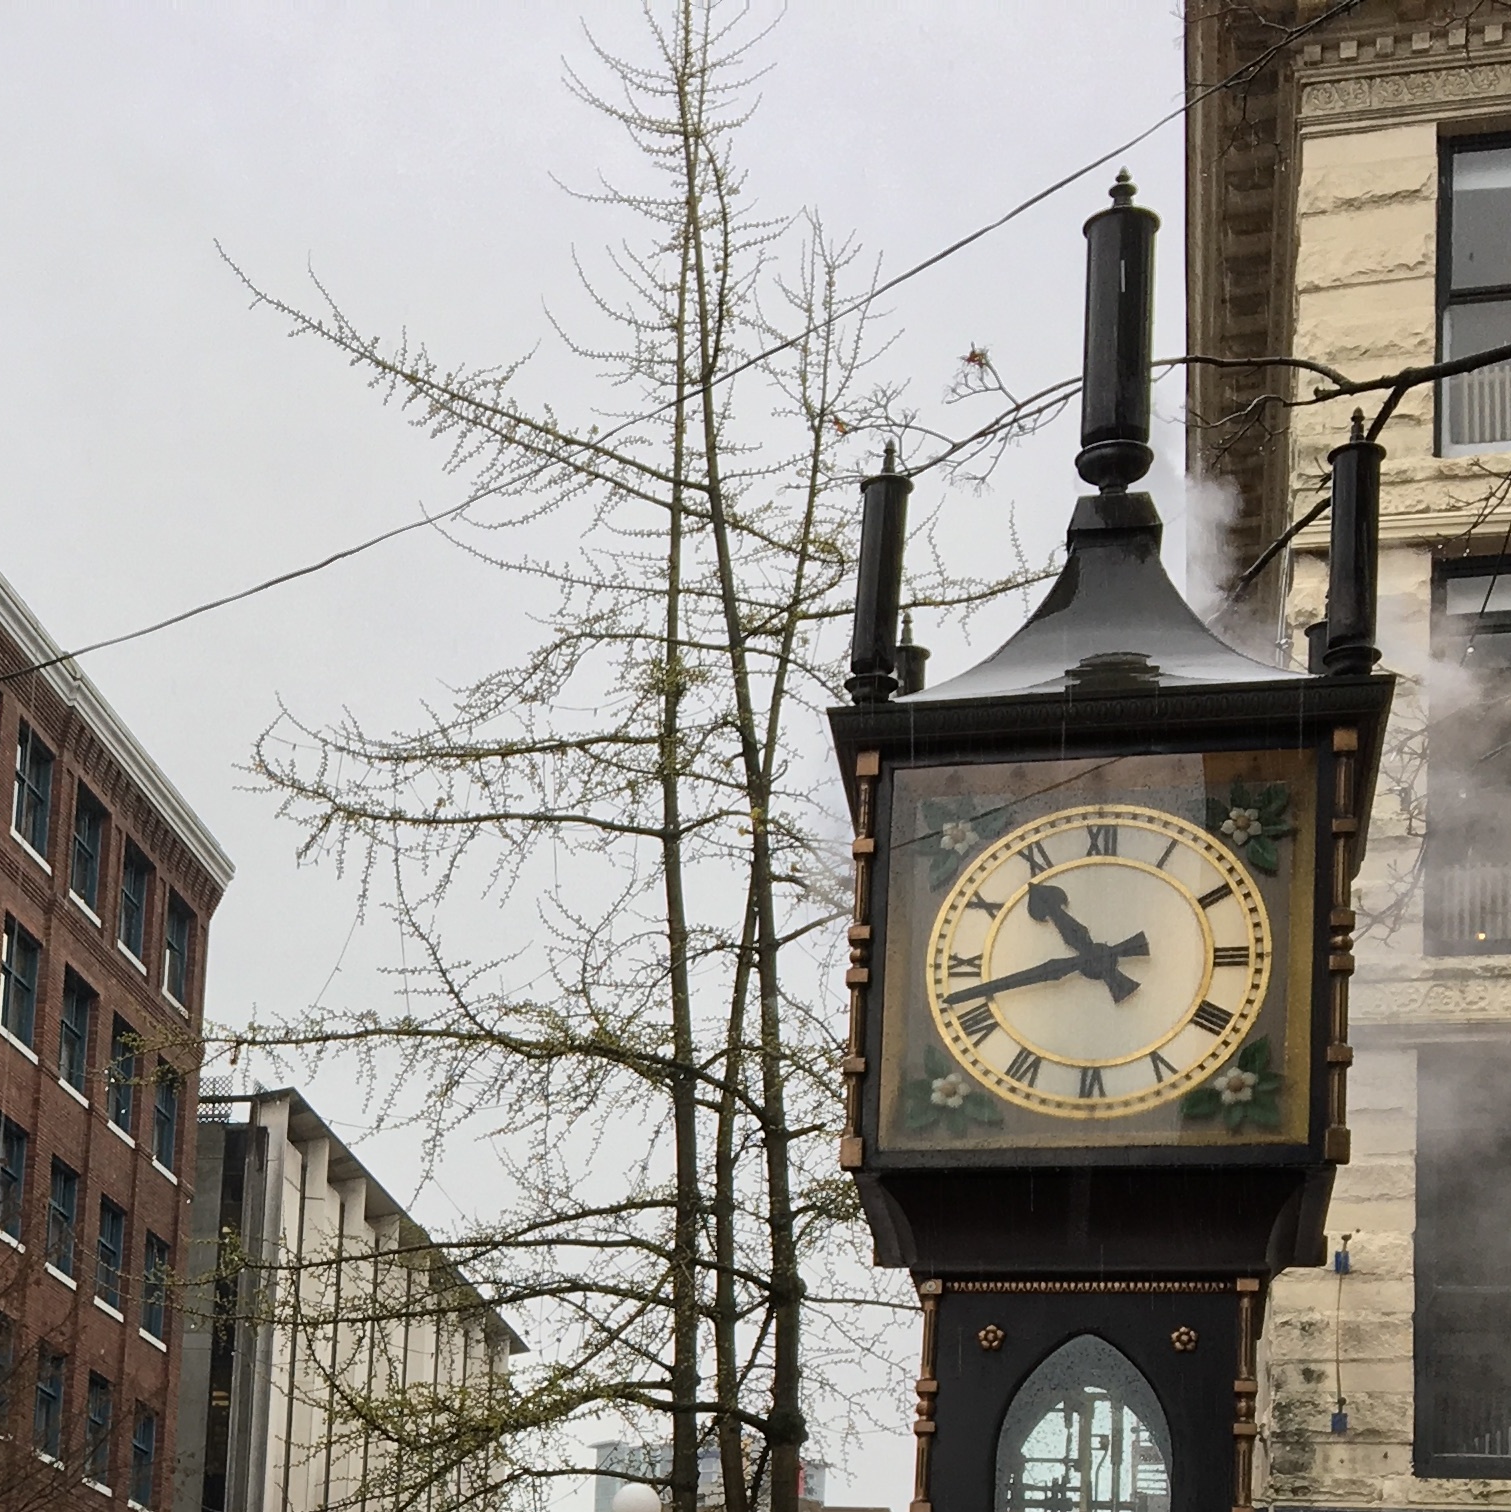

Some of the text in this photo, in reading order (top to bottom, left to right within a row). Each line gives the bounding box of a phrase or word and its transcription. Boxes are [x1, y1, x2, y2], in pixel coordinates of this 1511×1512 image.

[1087, 825, 1118, 857] XII
[1018, 841, 1054, 874] XI
[965, 891, 1004, 919] X
[1197, 882, 1234, 909] II
[948, 953, 983, 978] IX
[1213, 946, 1249, 967] III
[957, 1003, 999, 1048] VIII
[1005, 1048, 1042, 1088] VII
[1149, 1051, 1179, 1083] V
[1080, 1068, 1107, 1098] VI
